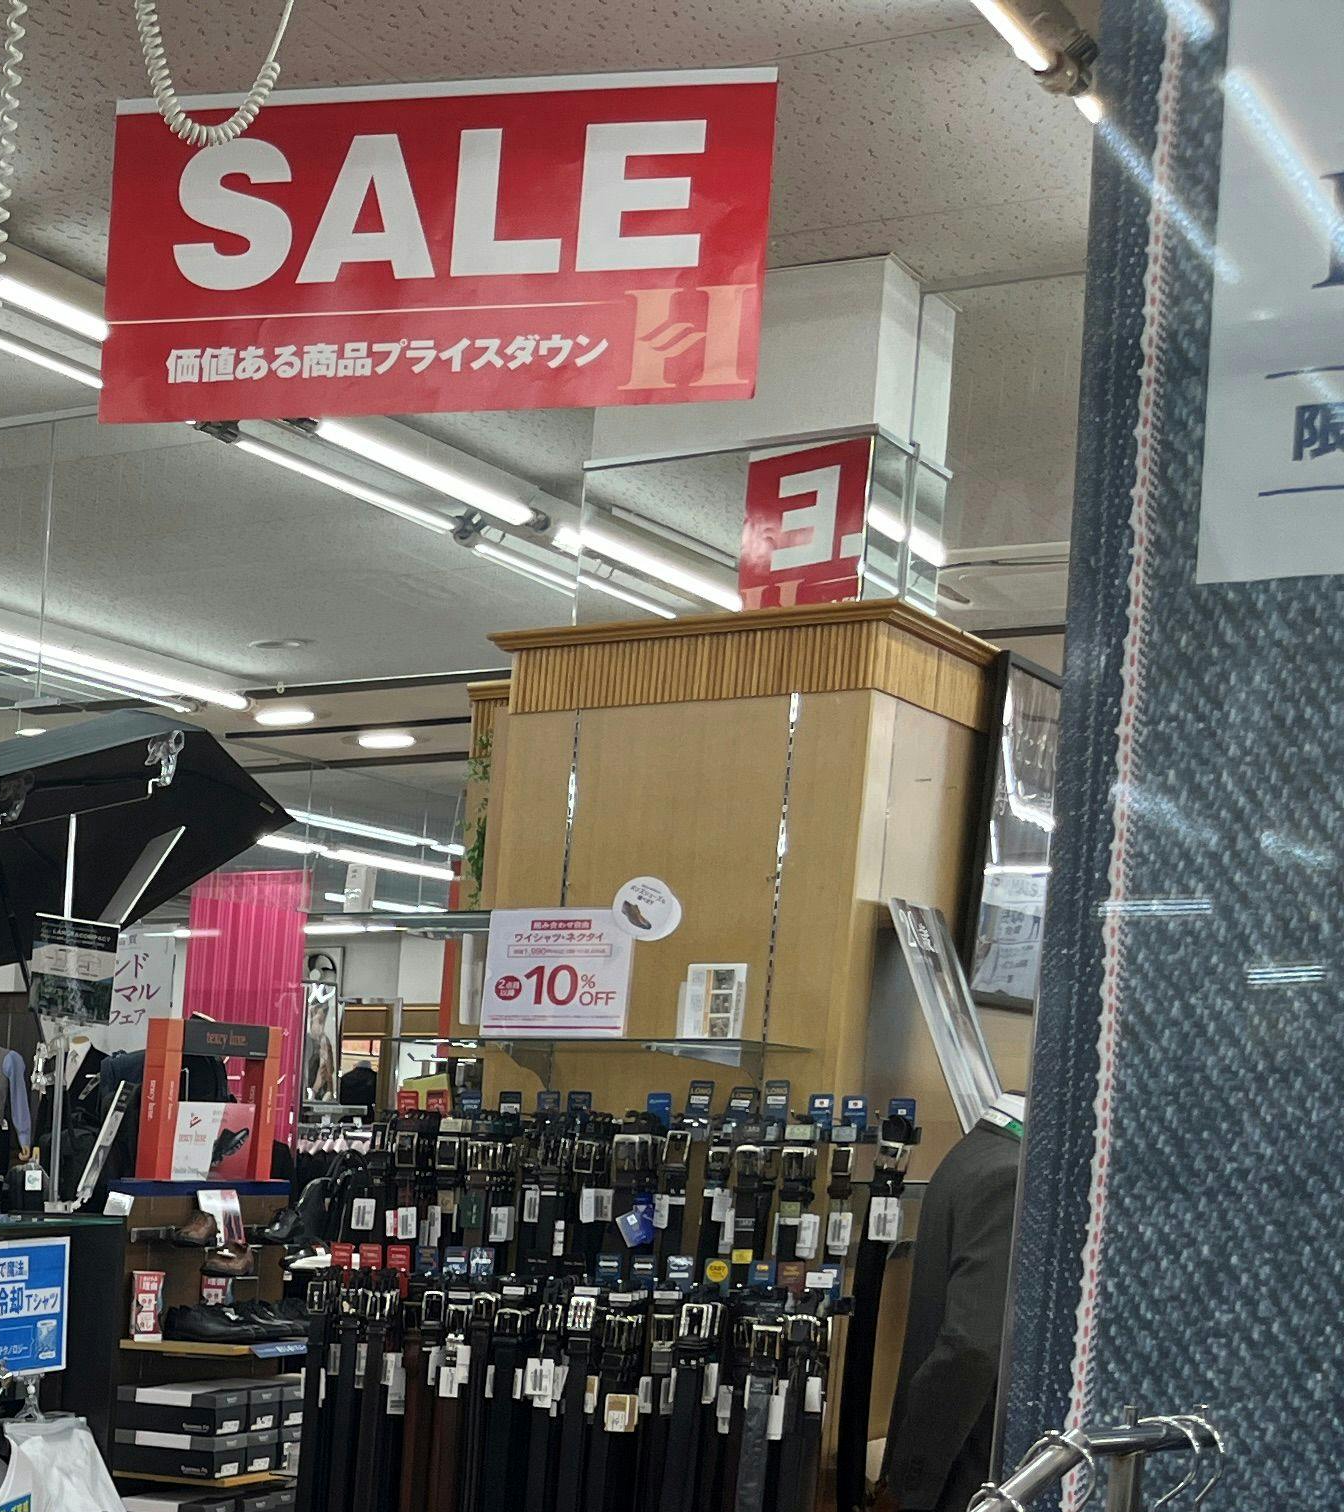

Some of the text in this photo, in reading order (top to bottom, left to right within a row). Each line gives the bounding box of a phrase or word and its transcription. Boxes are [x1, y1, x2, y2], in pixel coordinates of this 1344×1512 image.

[172, 119, 707, 291] SALE
[166, 333, 609, 385] 価値ある商品プライスダウン
[514, 932, 605, 943] ワイシャツ・ネクタイ
[579, 991, 616, 1006] OFF
